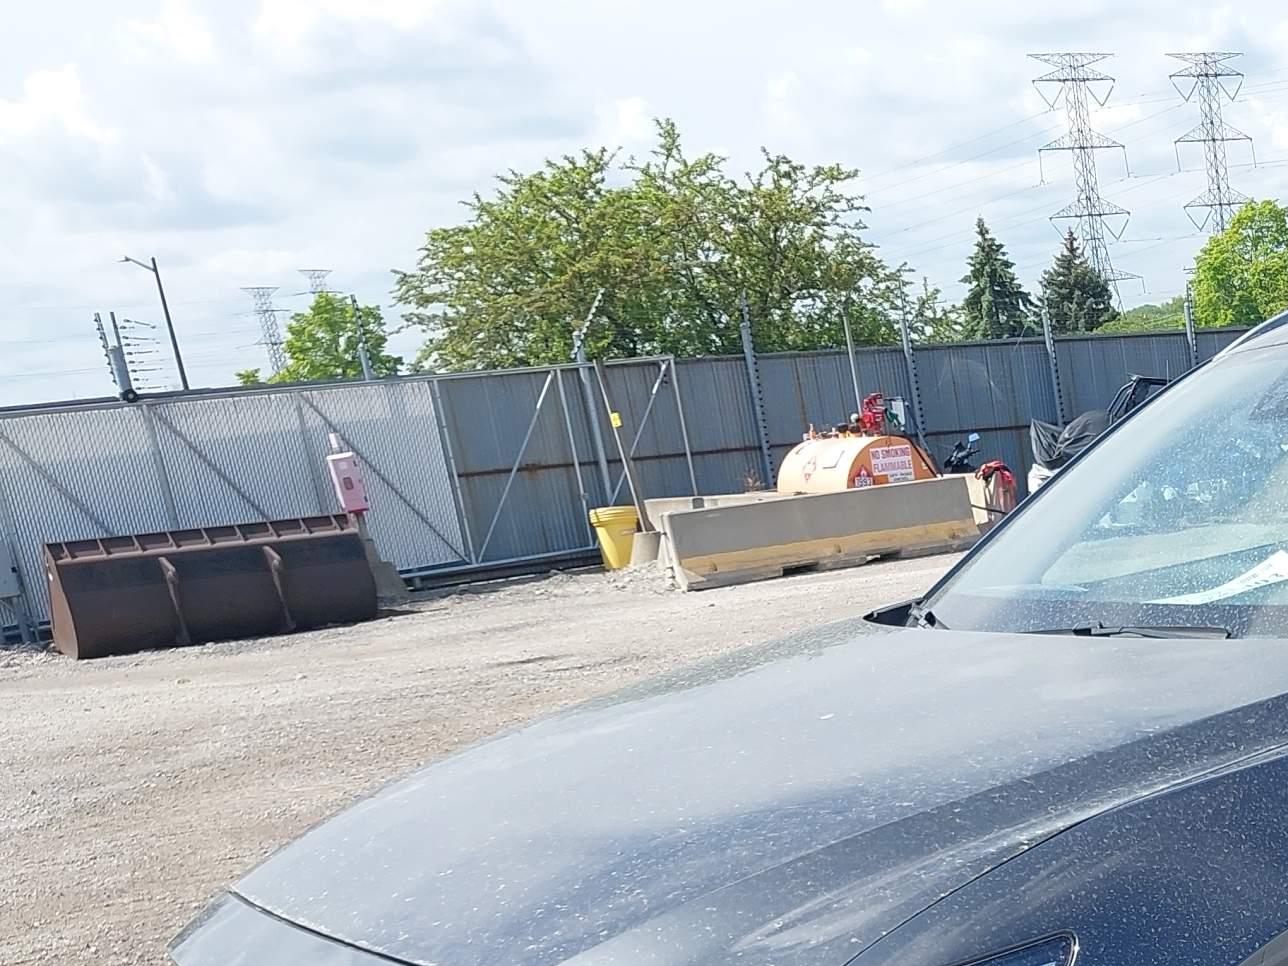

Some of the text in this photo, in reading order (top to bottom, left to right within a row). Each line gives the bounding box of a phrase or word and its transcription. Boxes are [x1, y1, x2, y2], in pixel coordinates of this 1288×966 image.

[871, 447, 911, 459] NO SMOKING
[873, 460, 912, 473] FLAMMABLE
